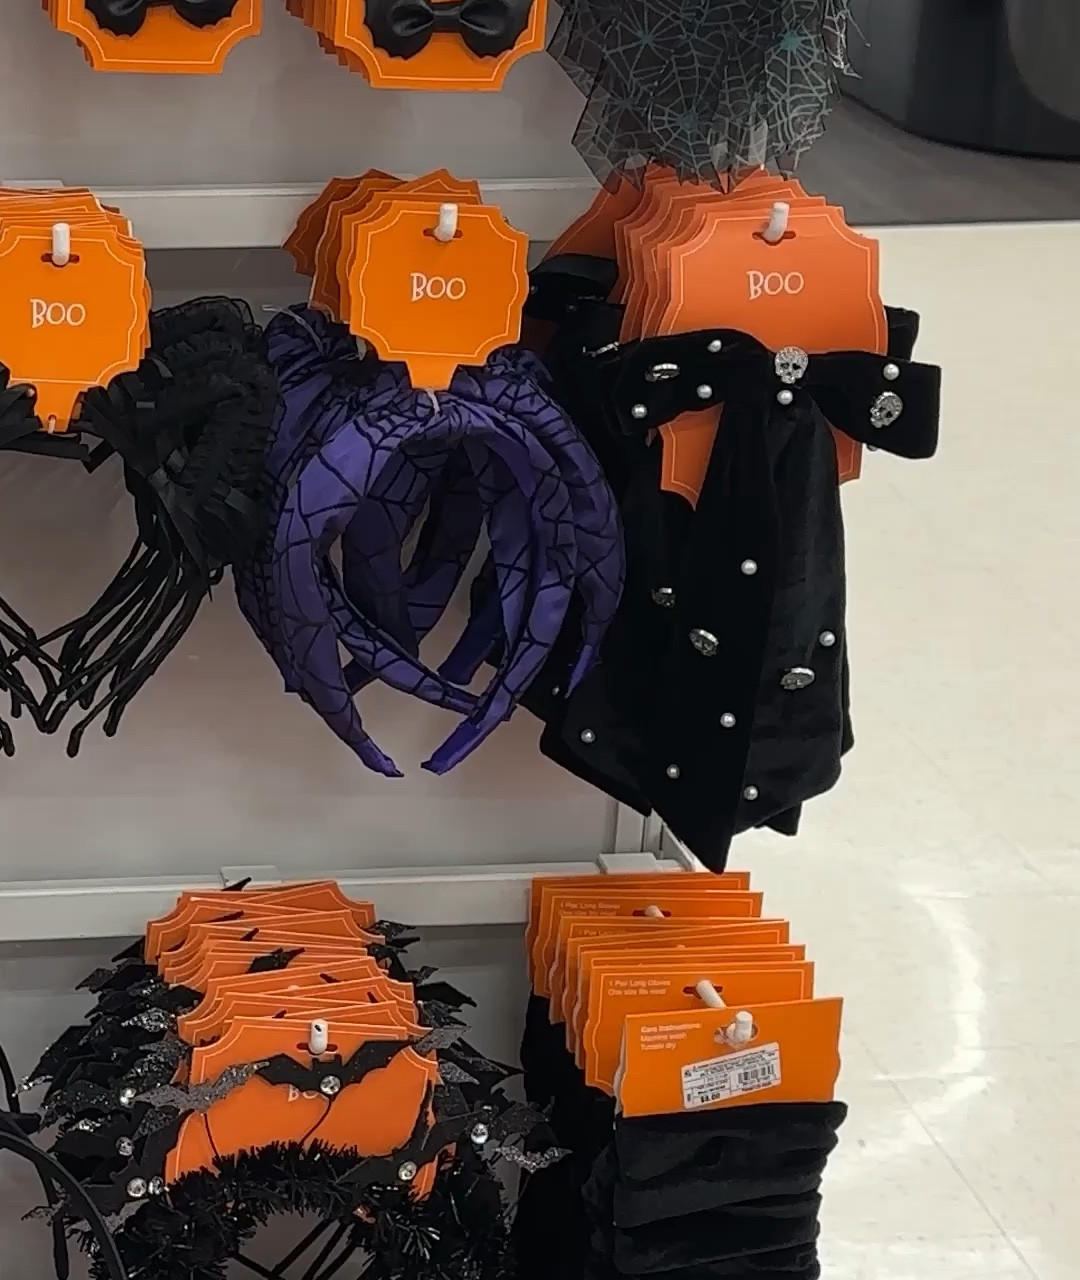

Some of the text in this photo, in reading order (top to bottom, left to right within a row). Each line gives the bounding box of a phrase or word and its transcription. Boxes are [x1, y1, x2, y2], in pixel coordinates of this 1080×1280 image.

[411, 272, 467, 302] BOO
[746, 270, 805, 300] BOO
[29, 298, 86, 329] BOO
